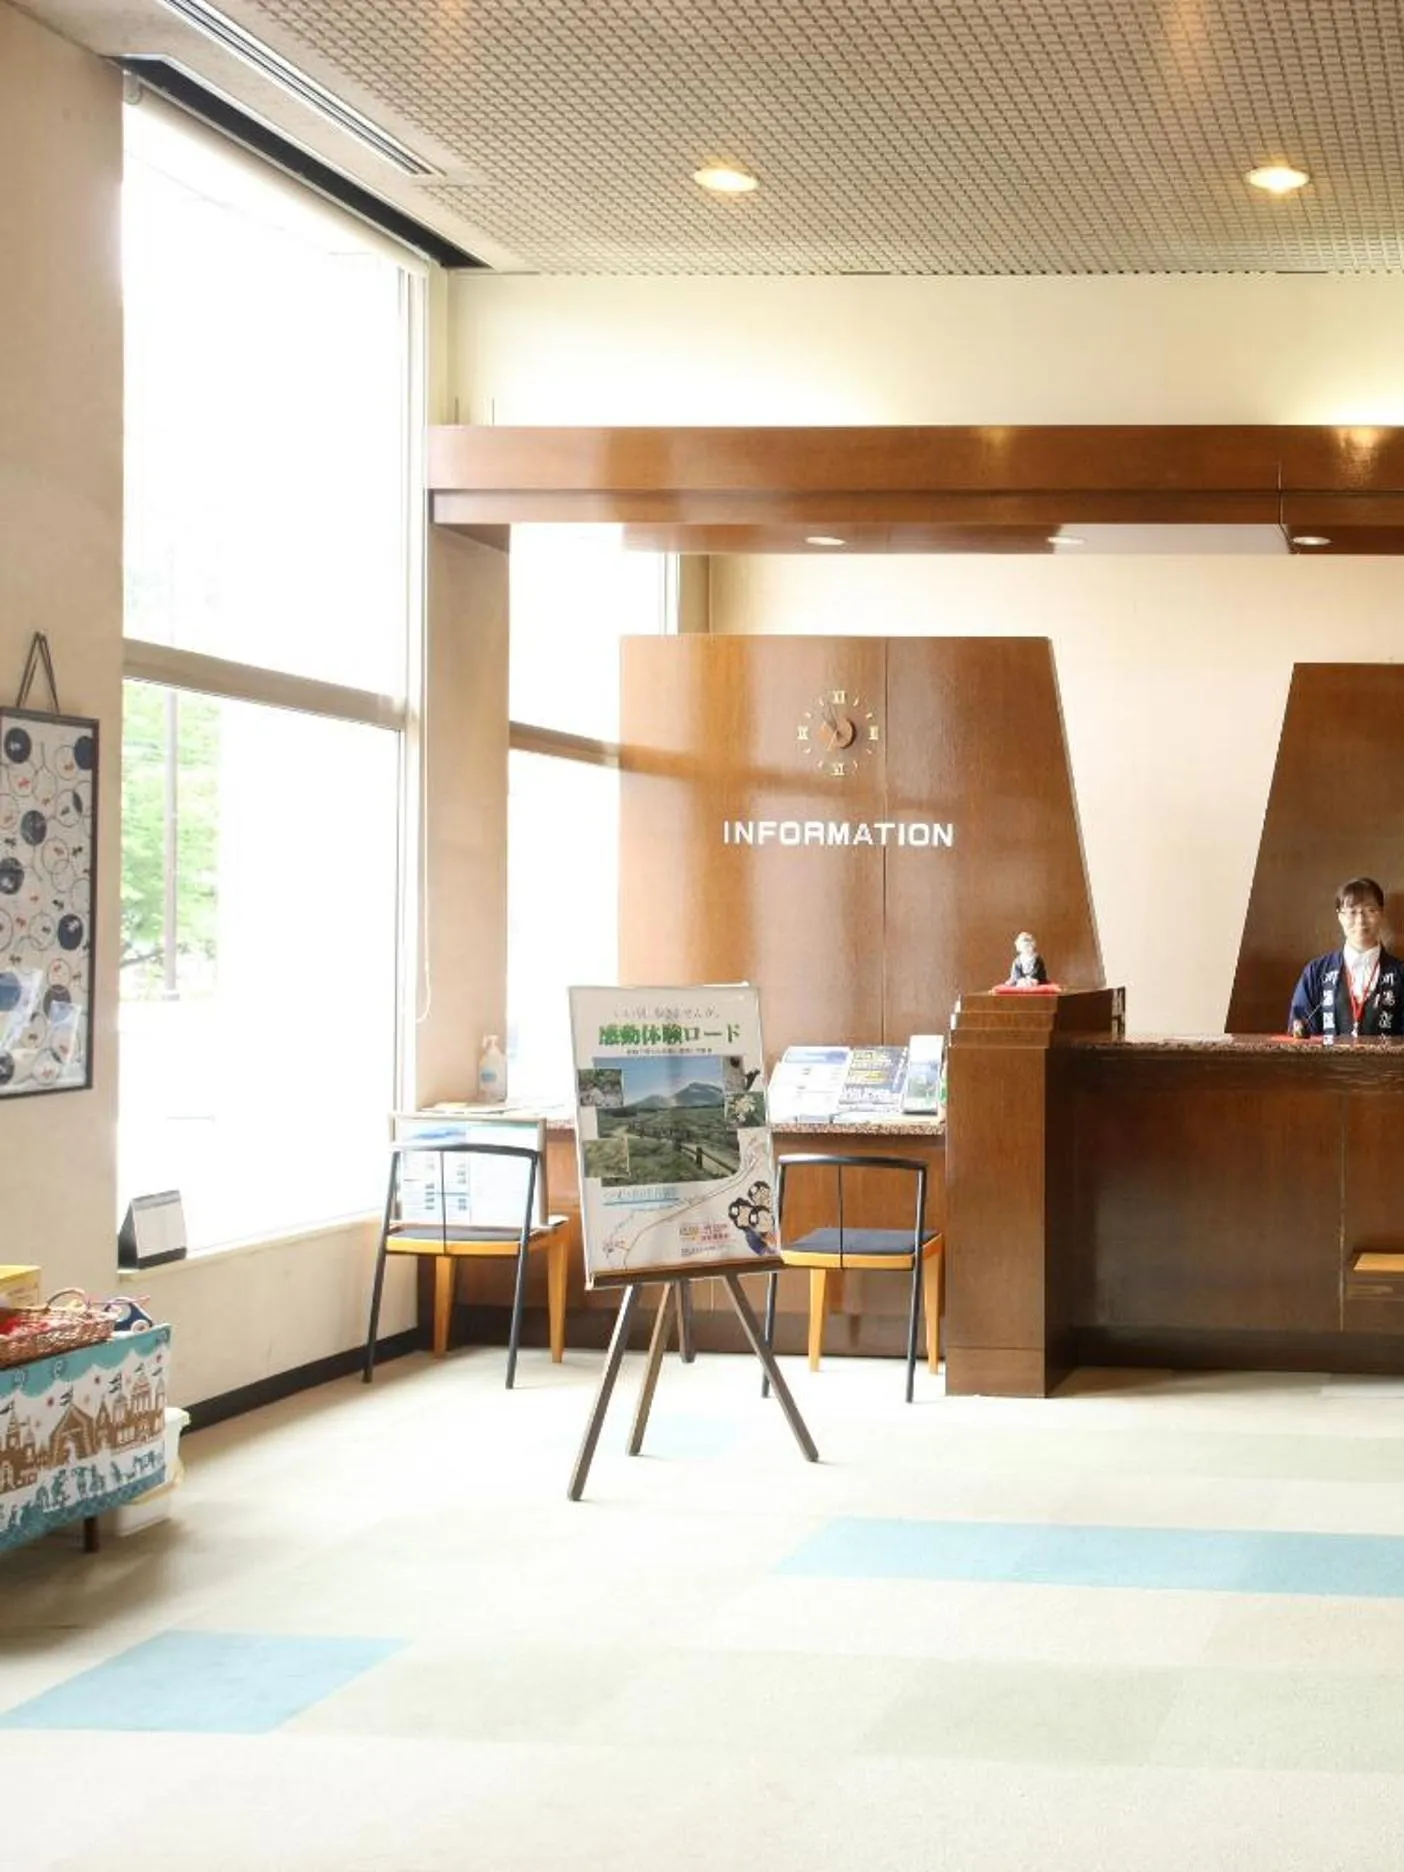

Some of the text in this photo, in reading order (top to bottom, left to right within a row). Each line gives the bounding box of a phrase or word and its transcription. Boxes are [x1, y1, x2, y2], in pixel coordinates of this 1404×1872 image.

[723, 820, 955, 847] INFORMATION
[598, 1023, 741, 1046] 感動体験ロード
